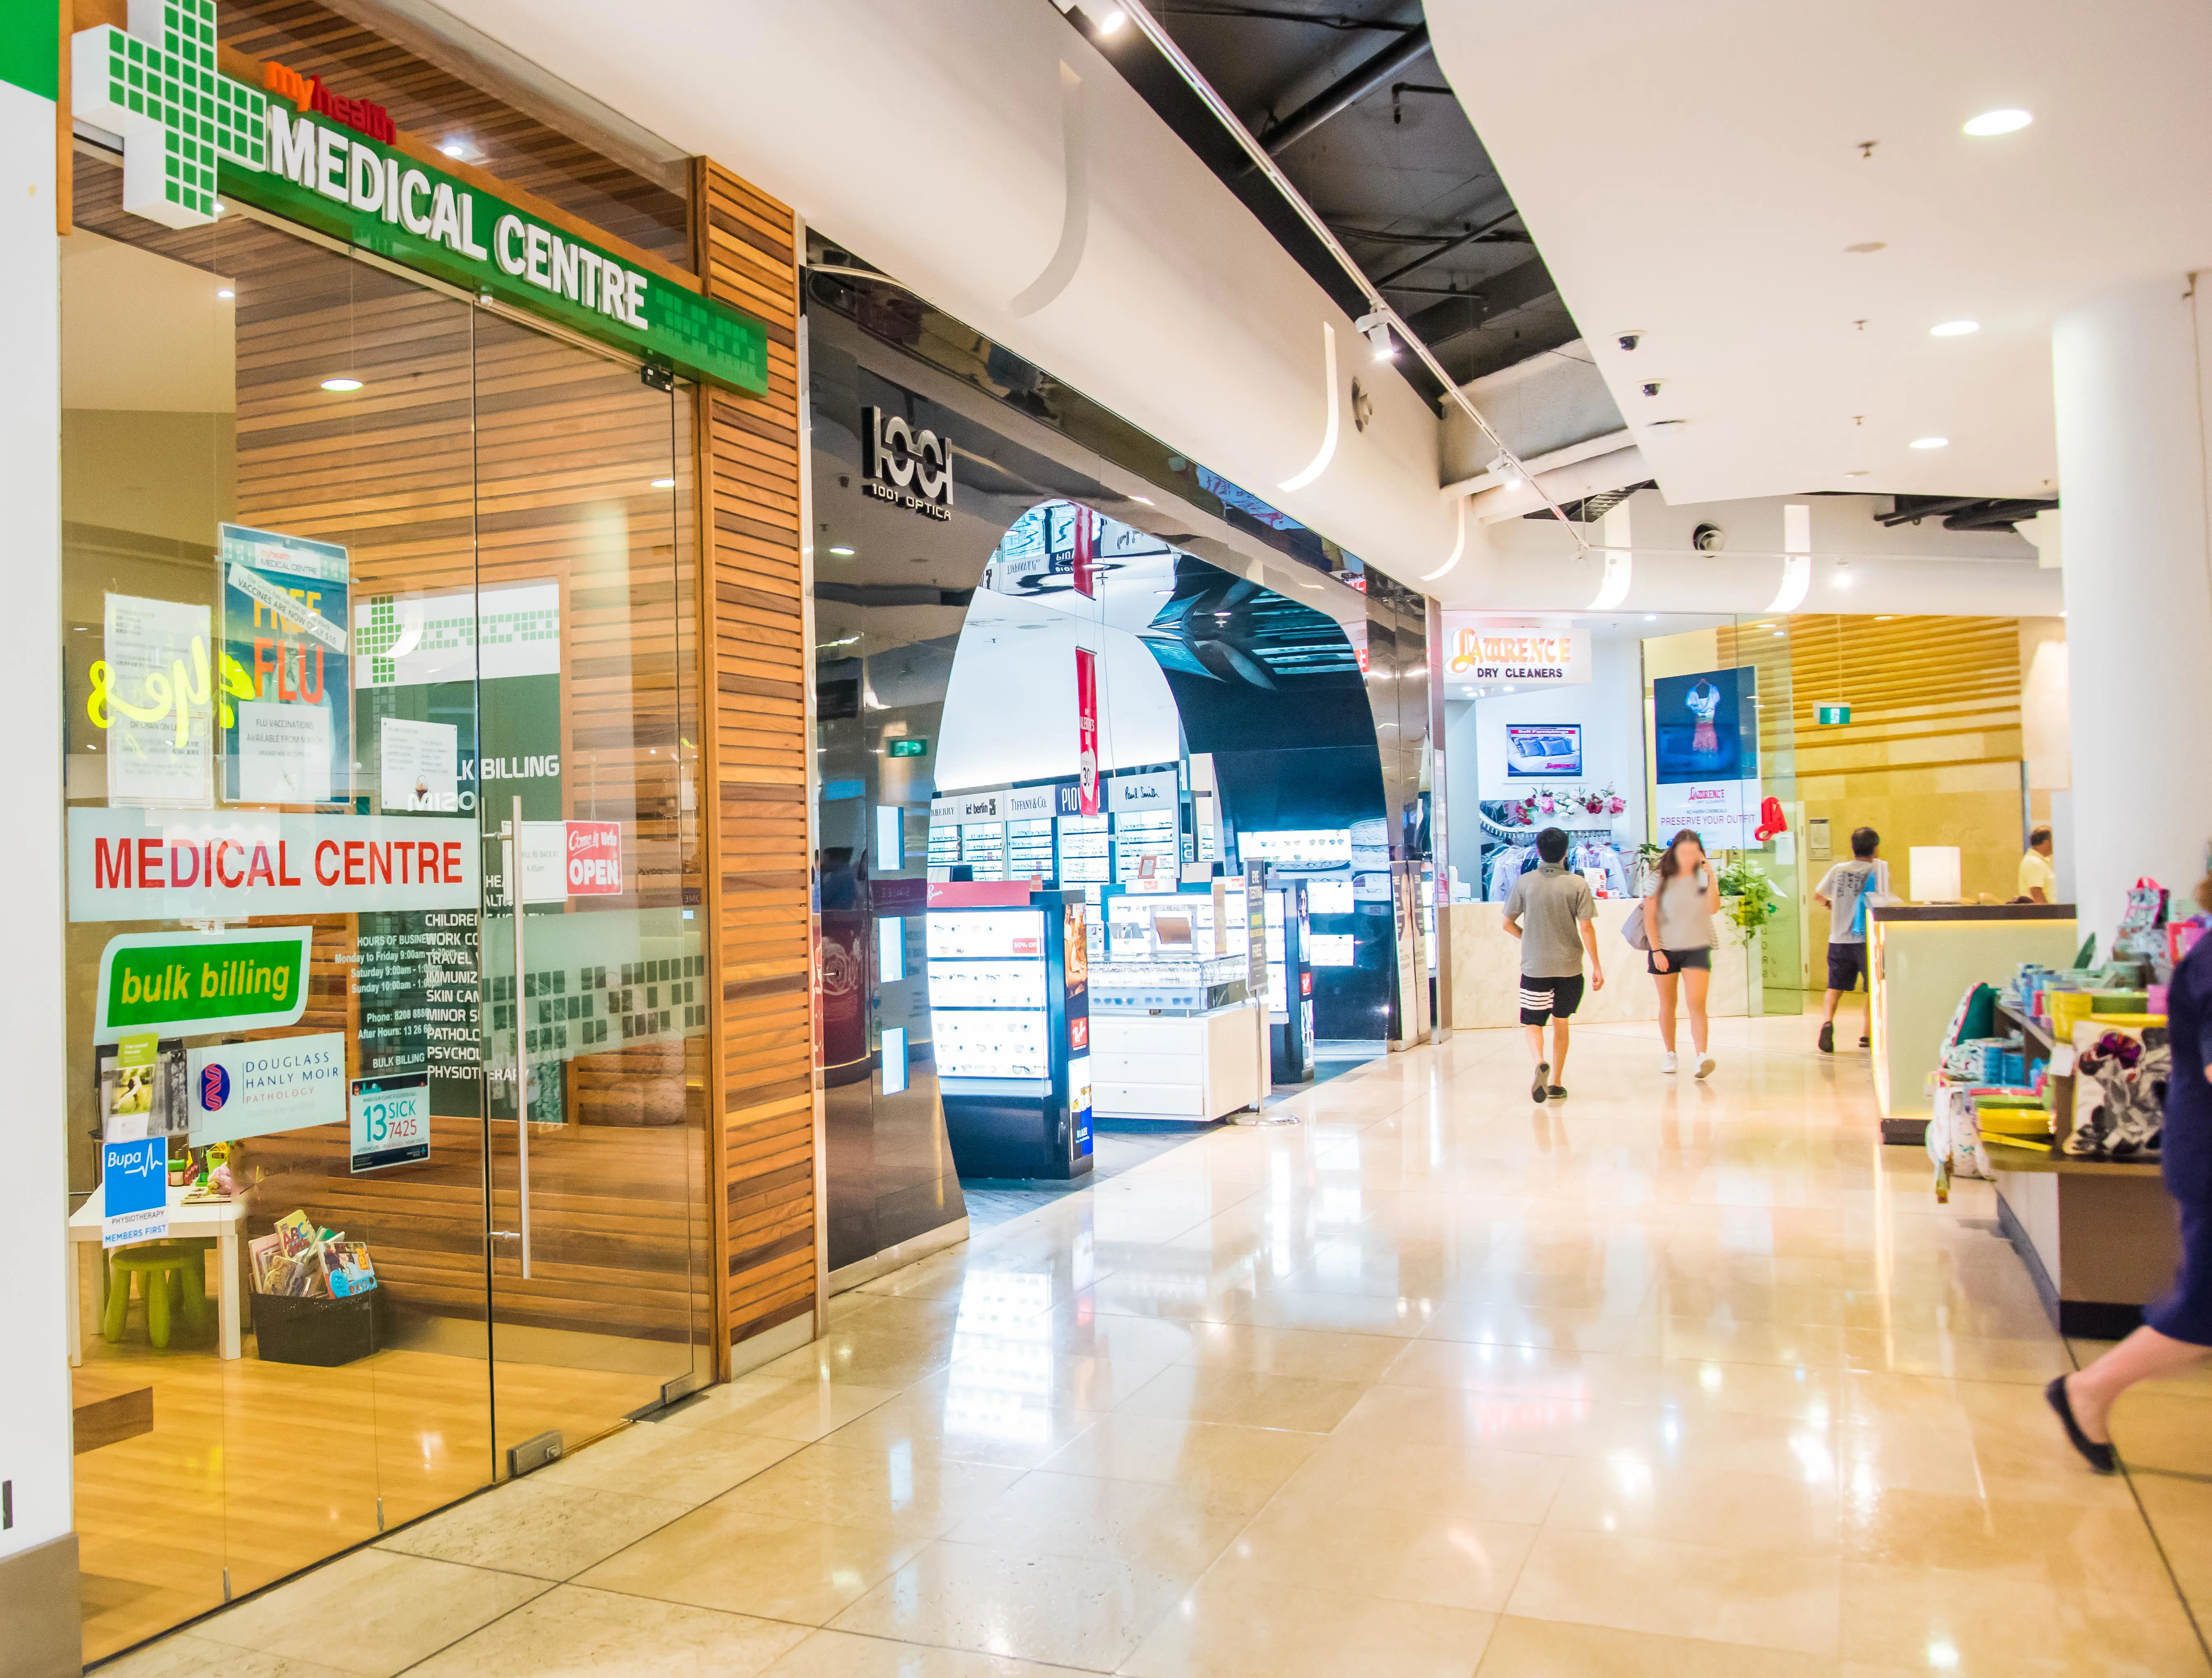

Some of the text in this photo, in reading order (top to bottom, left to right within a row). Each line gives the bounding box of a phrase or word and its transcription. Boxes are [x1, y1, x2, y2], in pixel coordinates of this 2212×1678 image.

[267, 104, 648, 330] MEDICAL CENTRE
[873, 483, 951, 521] 1001 OPTICA
[261, 558, 317, 575] MEDICAL CENTRE
[238, 578, 272, 604] VACCINES
[273, 601, 286, 614] ARE
[288, 609, 306, 625] NOW
[254, 637, 324, 704] FLU
[1477, 668, 1563, 678] DRY CLEANERS
[256, 719, 314, 729] FLU VACCINATIONS
[246, 734, 279, 743] AVAILABLE
[281, 735, 299, 743] FROM
[481, 755, 560, 780] BILLING
[1125, 786, 1160, 800] Paul Smith
[973, 802, 988, 814] berlin
[1661, 815, 1755, 826] PRESERVE YOUR OUTFIT
[569, 830, 592, 851] Come
[95, 837, 463, 889] MEDICAL CENTRE
[569, 858, 619, 885] OPEN
[928, 884, 943, 901] Ban
[357, 936, 385, 947] HOURS
[387, 935, 397, 945] OF
[335, 953, 365, 965] Monday
[366, 953, 374, 962] to
[376, 952, 399, 963] Friday
[400, 950, 426, 960] 9:00am
[426, 952, 472, 965] TRAVEL
[351, 968, 383, 979] Saturday
[386, 966, 411, 976] 9:00am
[122, 959, 289, 1004] bulk billing
[351, 983, 380, 994] Sunday
[381, 981, 411, 991] 10:00am
[426, 990, 453, 1003] SKIN
[367, 1012, 392, 1023] Phone:
[427, 1009, 466, 1022] MINOR
[358, 1029, 376, 1040] After
[377, 1026, 401, 1038] Hours:
[403, 1026, 412, 1036] 13
[413, 1025, 422, 1034] 26
[246, 1052, 329, 1072] DOUGLASS
[372, 1053, 425, 1069] BULK BILLING
[246, 1067, 339, 1089] HANLY MOIR
[246, 1087, 314, 1103] PATHOLOGY
[363, 1099, 416, 1142] 13 SICK
[389, 1119, 417, 1138] 7425
[108, 1152, 142, 1169] Bupa
[111, 1210, 164, 1225] PHYSIOTHERAPY
[105, 1224, 166, 1243] MEMBERS FIRST
[283, 1222, 308, 1250] ABC
